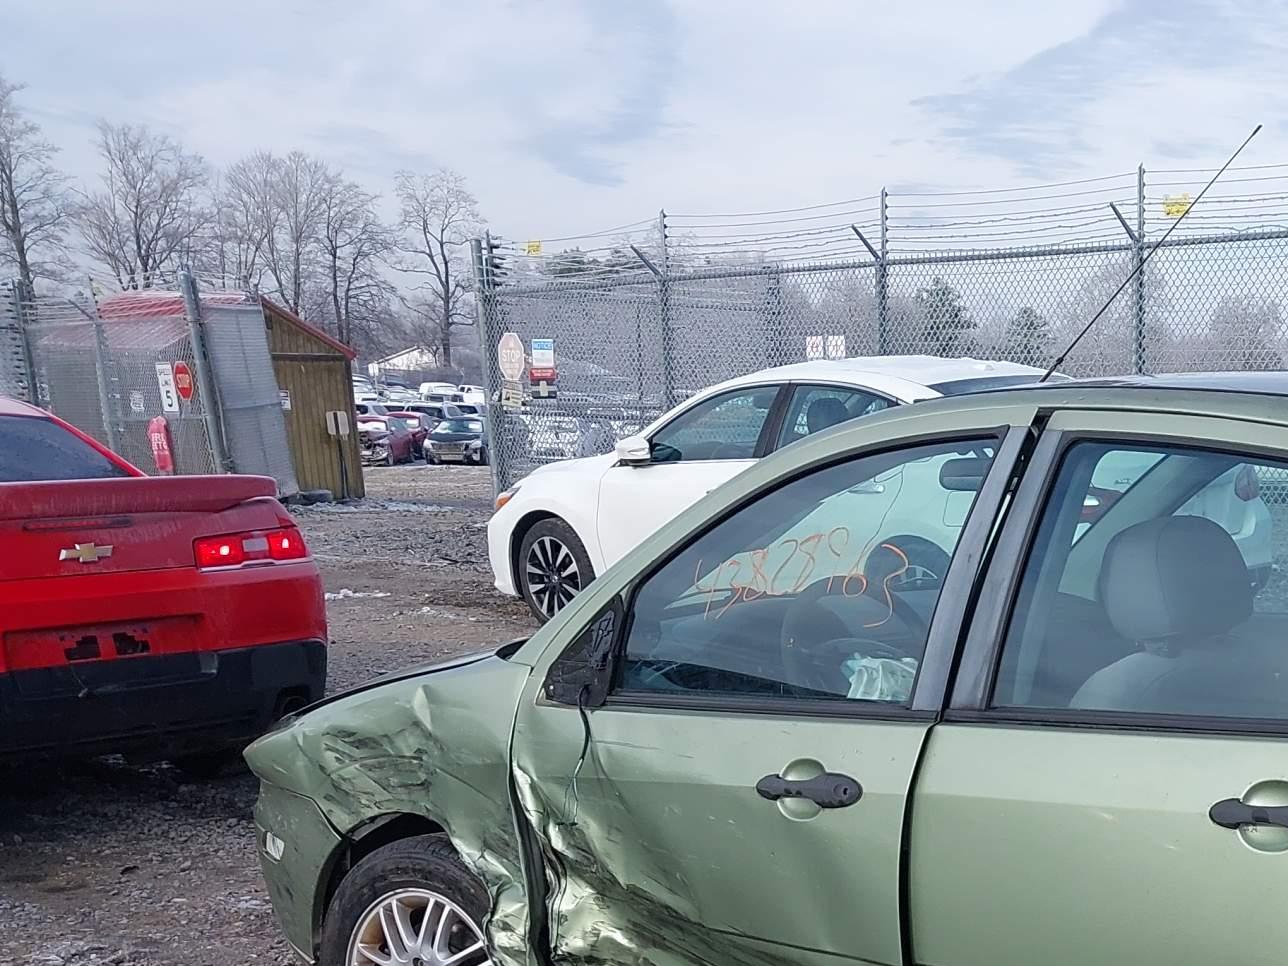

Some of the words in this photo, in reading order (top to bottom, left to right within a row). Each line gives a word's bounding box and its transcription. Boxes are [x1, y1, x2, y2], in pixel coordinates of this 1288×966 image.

[501, 349, 521, 362] STOP
[175, 373, 190, 388] STOP
[164, 390, 173, 408] 5
[694, 527, 910, 629] 43828963
